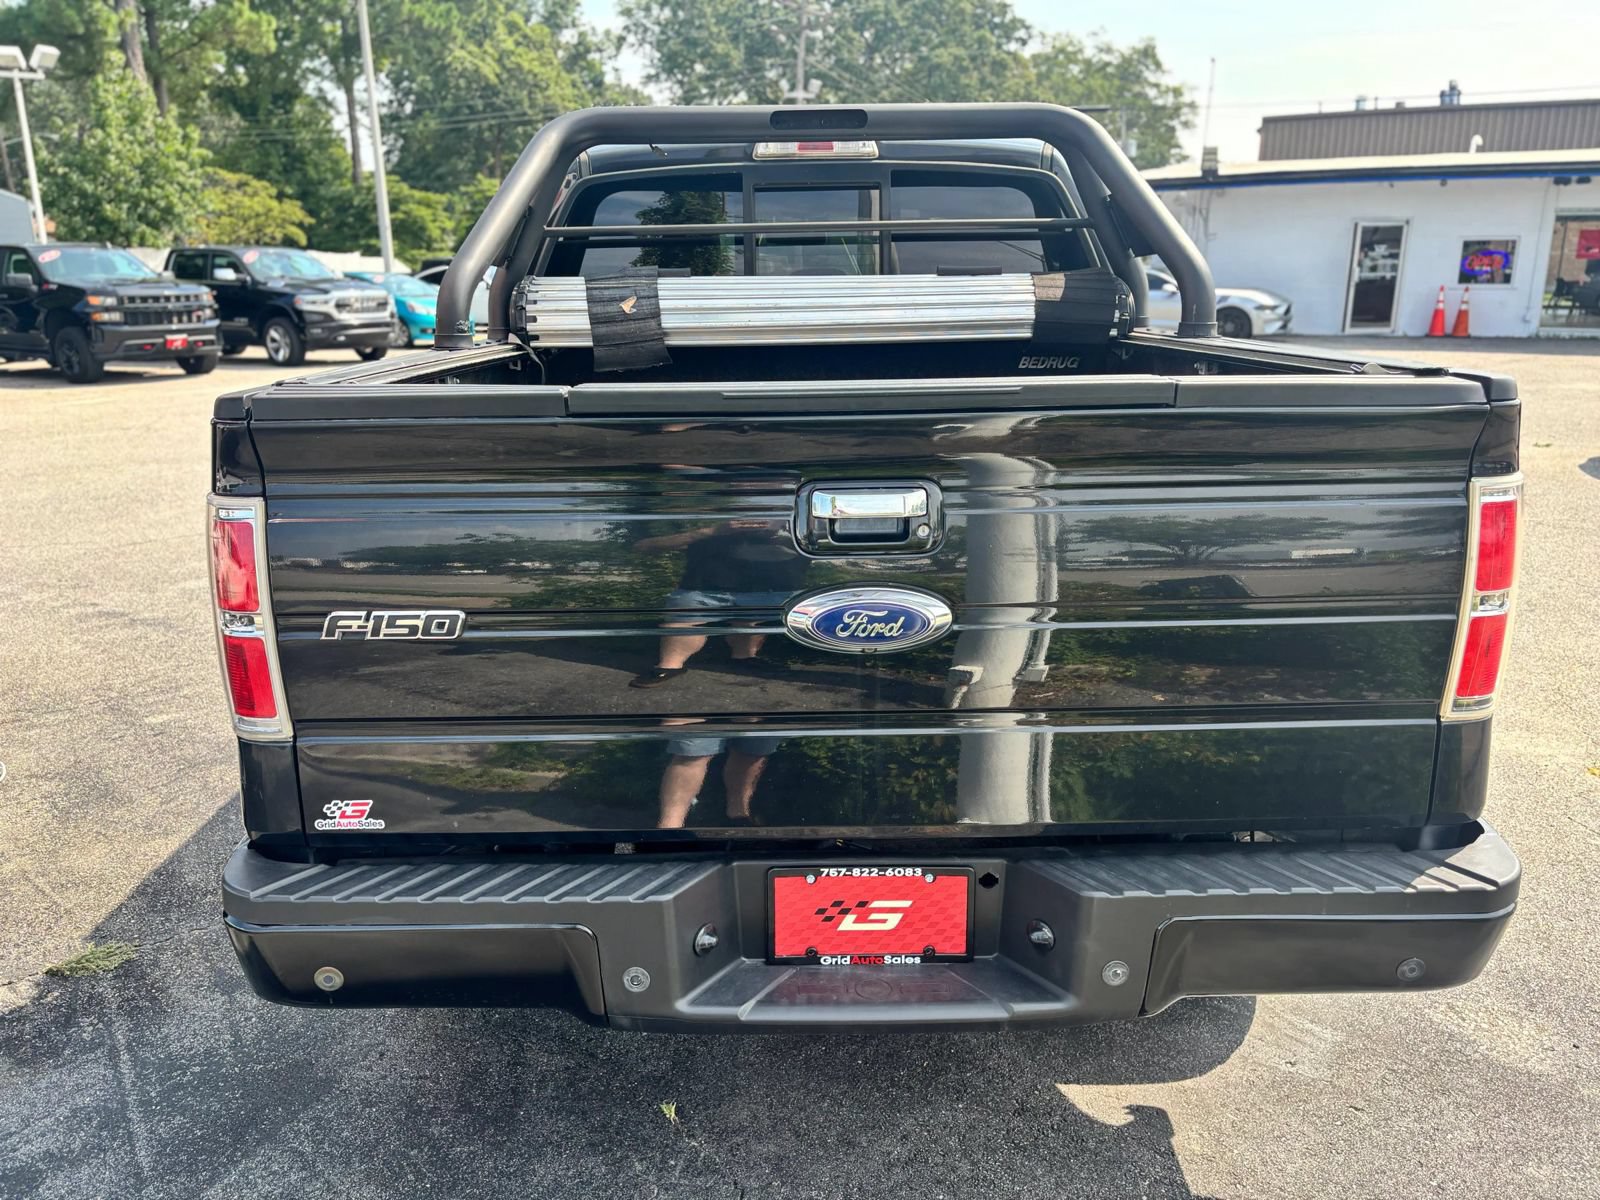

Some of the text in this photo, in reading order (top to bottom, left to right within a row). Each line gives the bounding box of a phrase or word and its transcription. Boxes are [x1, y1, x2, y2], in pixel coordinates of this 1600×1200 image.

[1018, 356, 1080, 369] BEDRUG
[320, 610, 467, 641] F-150
[835, 609, 905, 637] Ford
[315, 819, 384, 829] GridAutoSales
[820, 868, 923, 877] 757-822-6083
[820, 955, 921, 965] GridAutoSales
